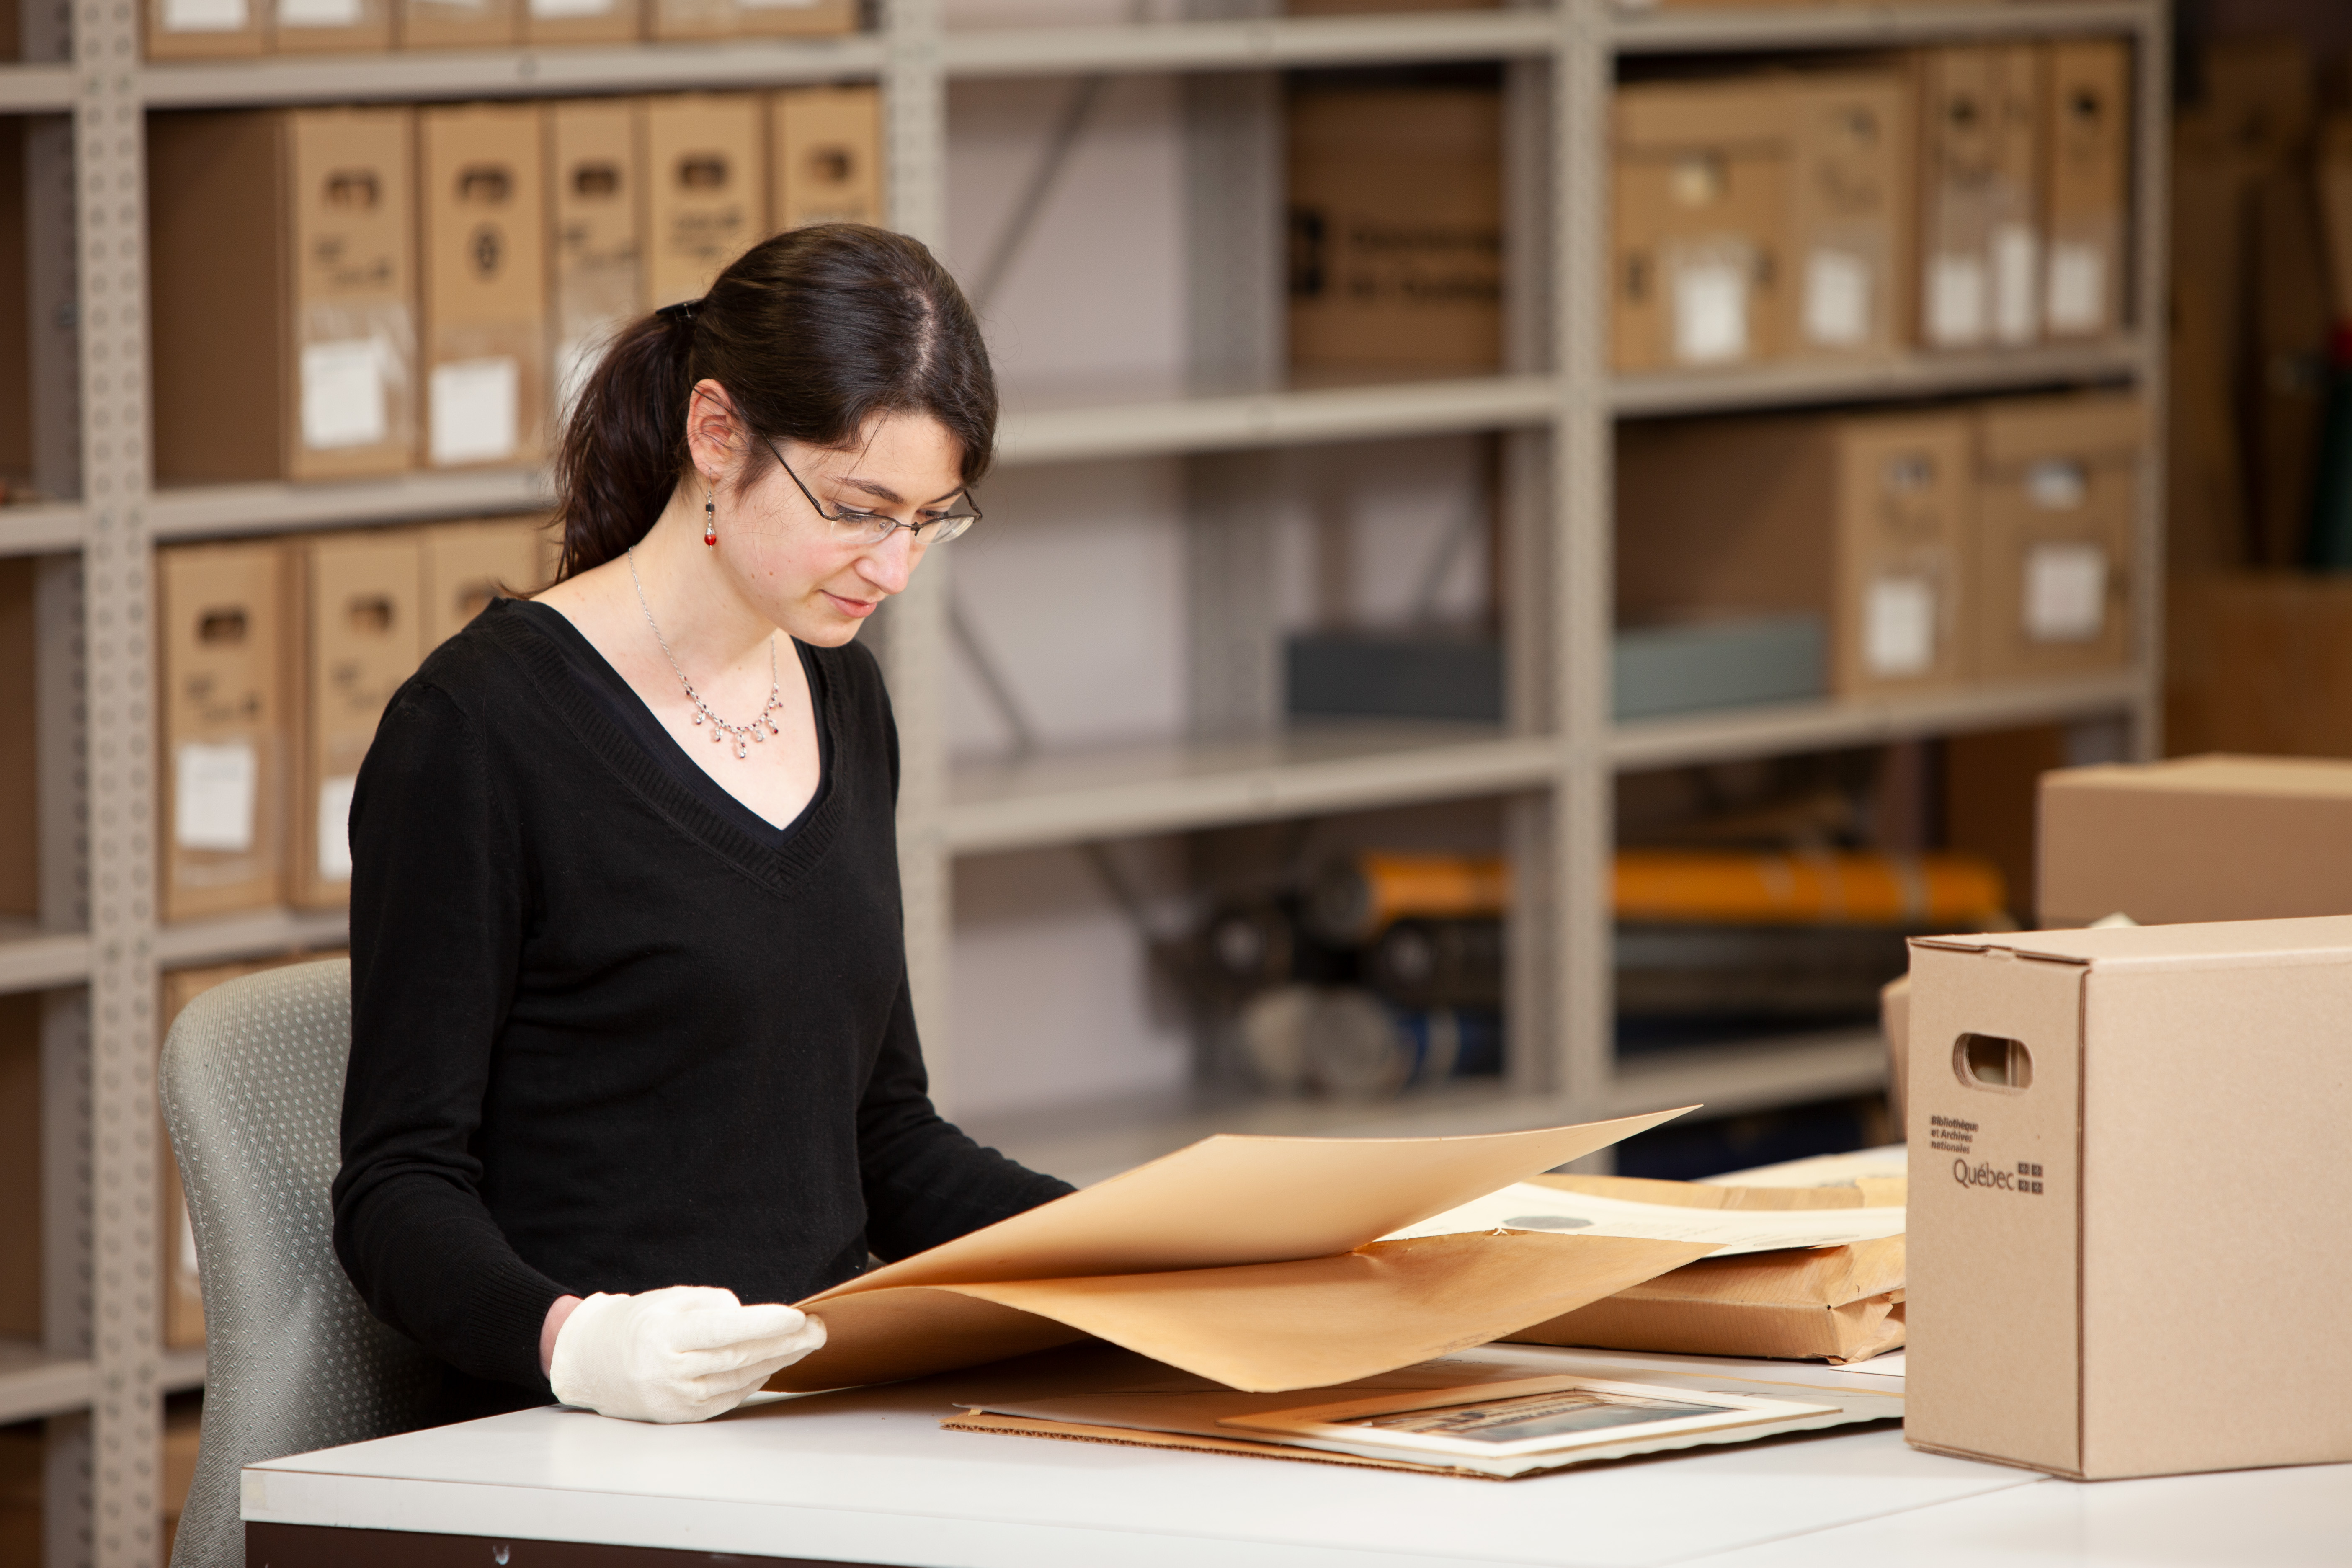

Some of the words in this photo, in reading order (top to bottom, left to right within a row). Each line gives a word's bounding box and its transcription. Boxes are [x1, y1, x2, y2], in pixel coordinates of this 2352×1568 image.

[1931, 1115, 1978, 1132] Bibliothèque
[1931, 1129, 1940, 1138] et
[1941, 1130, 1973, 1143] Archives
[1931, 1141, 1970, 1154] nationales
[1954, 1158, 2015, 1191] Québec
